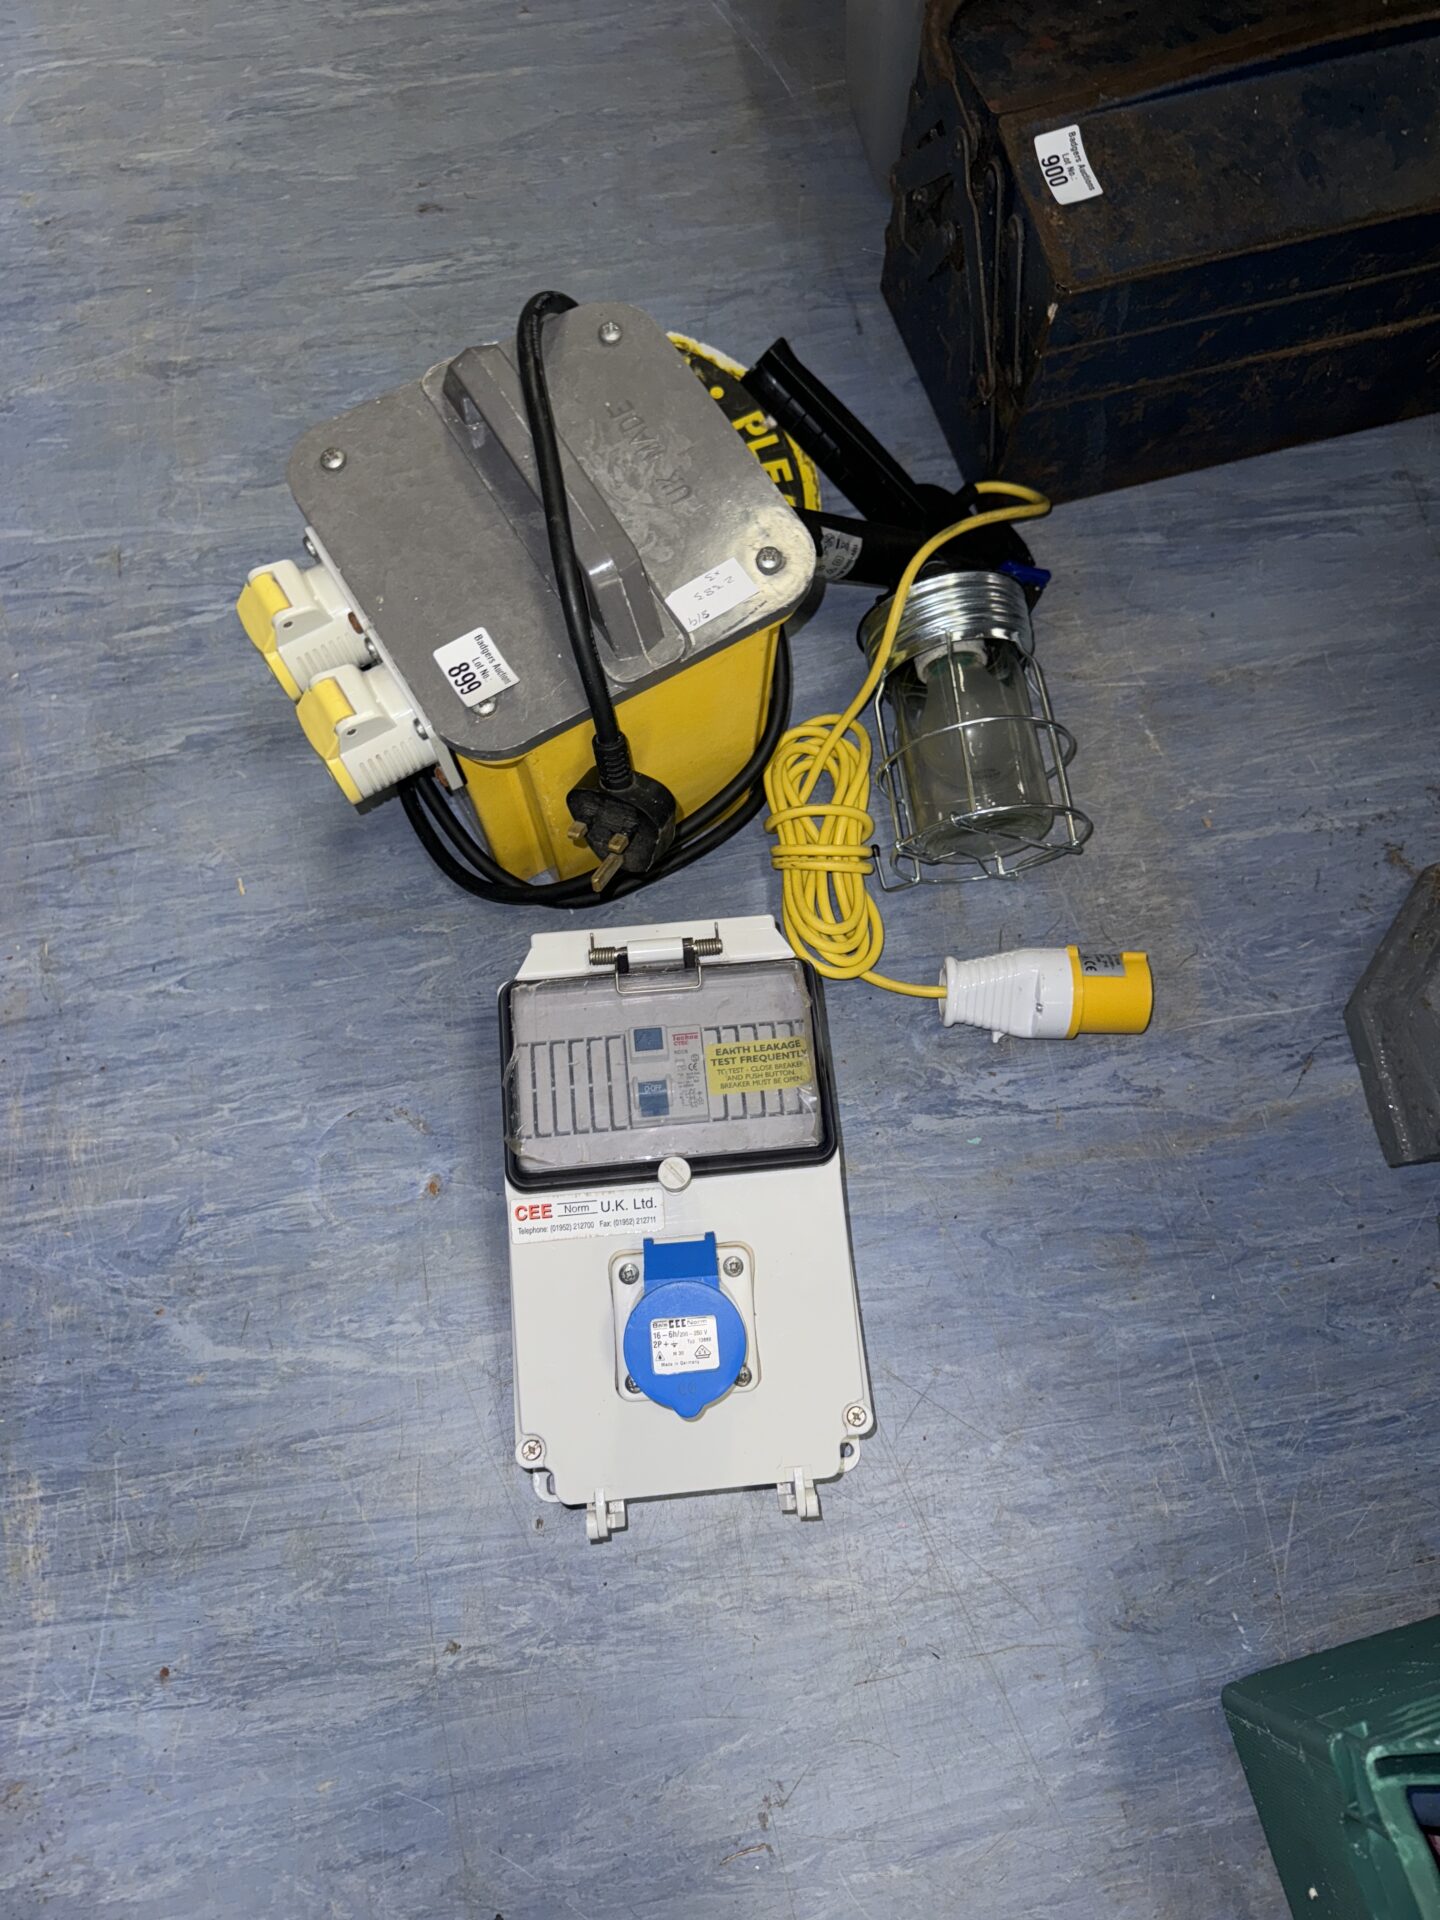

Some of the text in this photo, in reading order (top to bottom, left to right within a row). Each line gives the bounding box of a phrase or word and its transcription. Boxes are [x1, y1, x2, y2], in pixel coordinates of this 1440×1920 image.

[1062, 153, 1071, 165] Lot
[1068, 131, 1095, 191] Badgers Auctions
[1041, 154, 1068, 187] 900
[605, 400, 666, 462] MADE
[474, 634, 496, 664] Badgers
[471, 657, 483, 670] Lot
[448, 662, 482, 695] 899
[715, 1040, 801, 1056] EARTH LEAKAGE
[710, 1049, 808, 1066] TEST FREQUENTLY
[751, 1064, 773, 1072] CLOSE
[720, 1081, 750, 1089] BREAKER
[514, 1197, 657, 1221] CEE Norm U.K. Ltd.
[518, 1216, 656, 1235] Telephone: (01952) 212700 Fax: (01952) 212711
[668, 1319, 686, 1328] CEE
[653, 1341, 662, 1349] 2P
